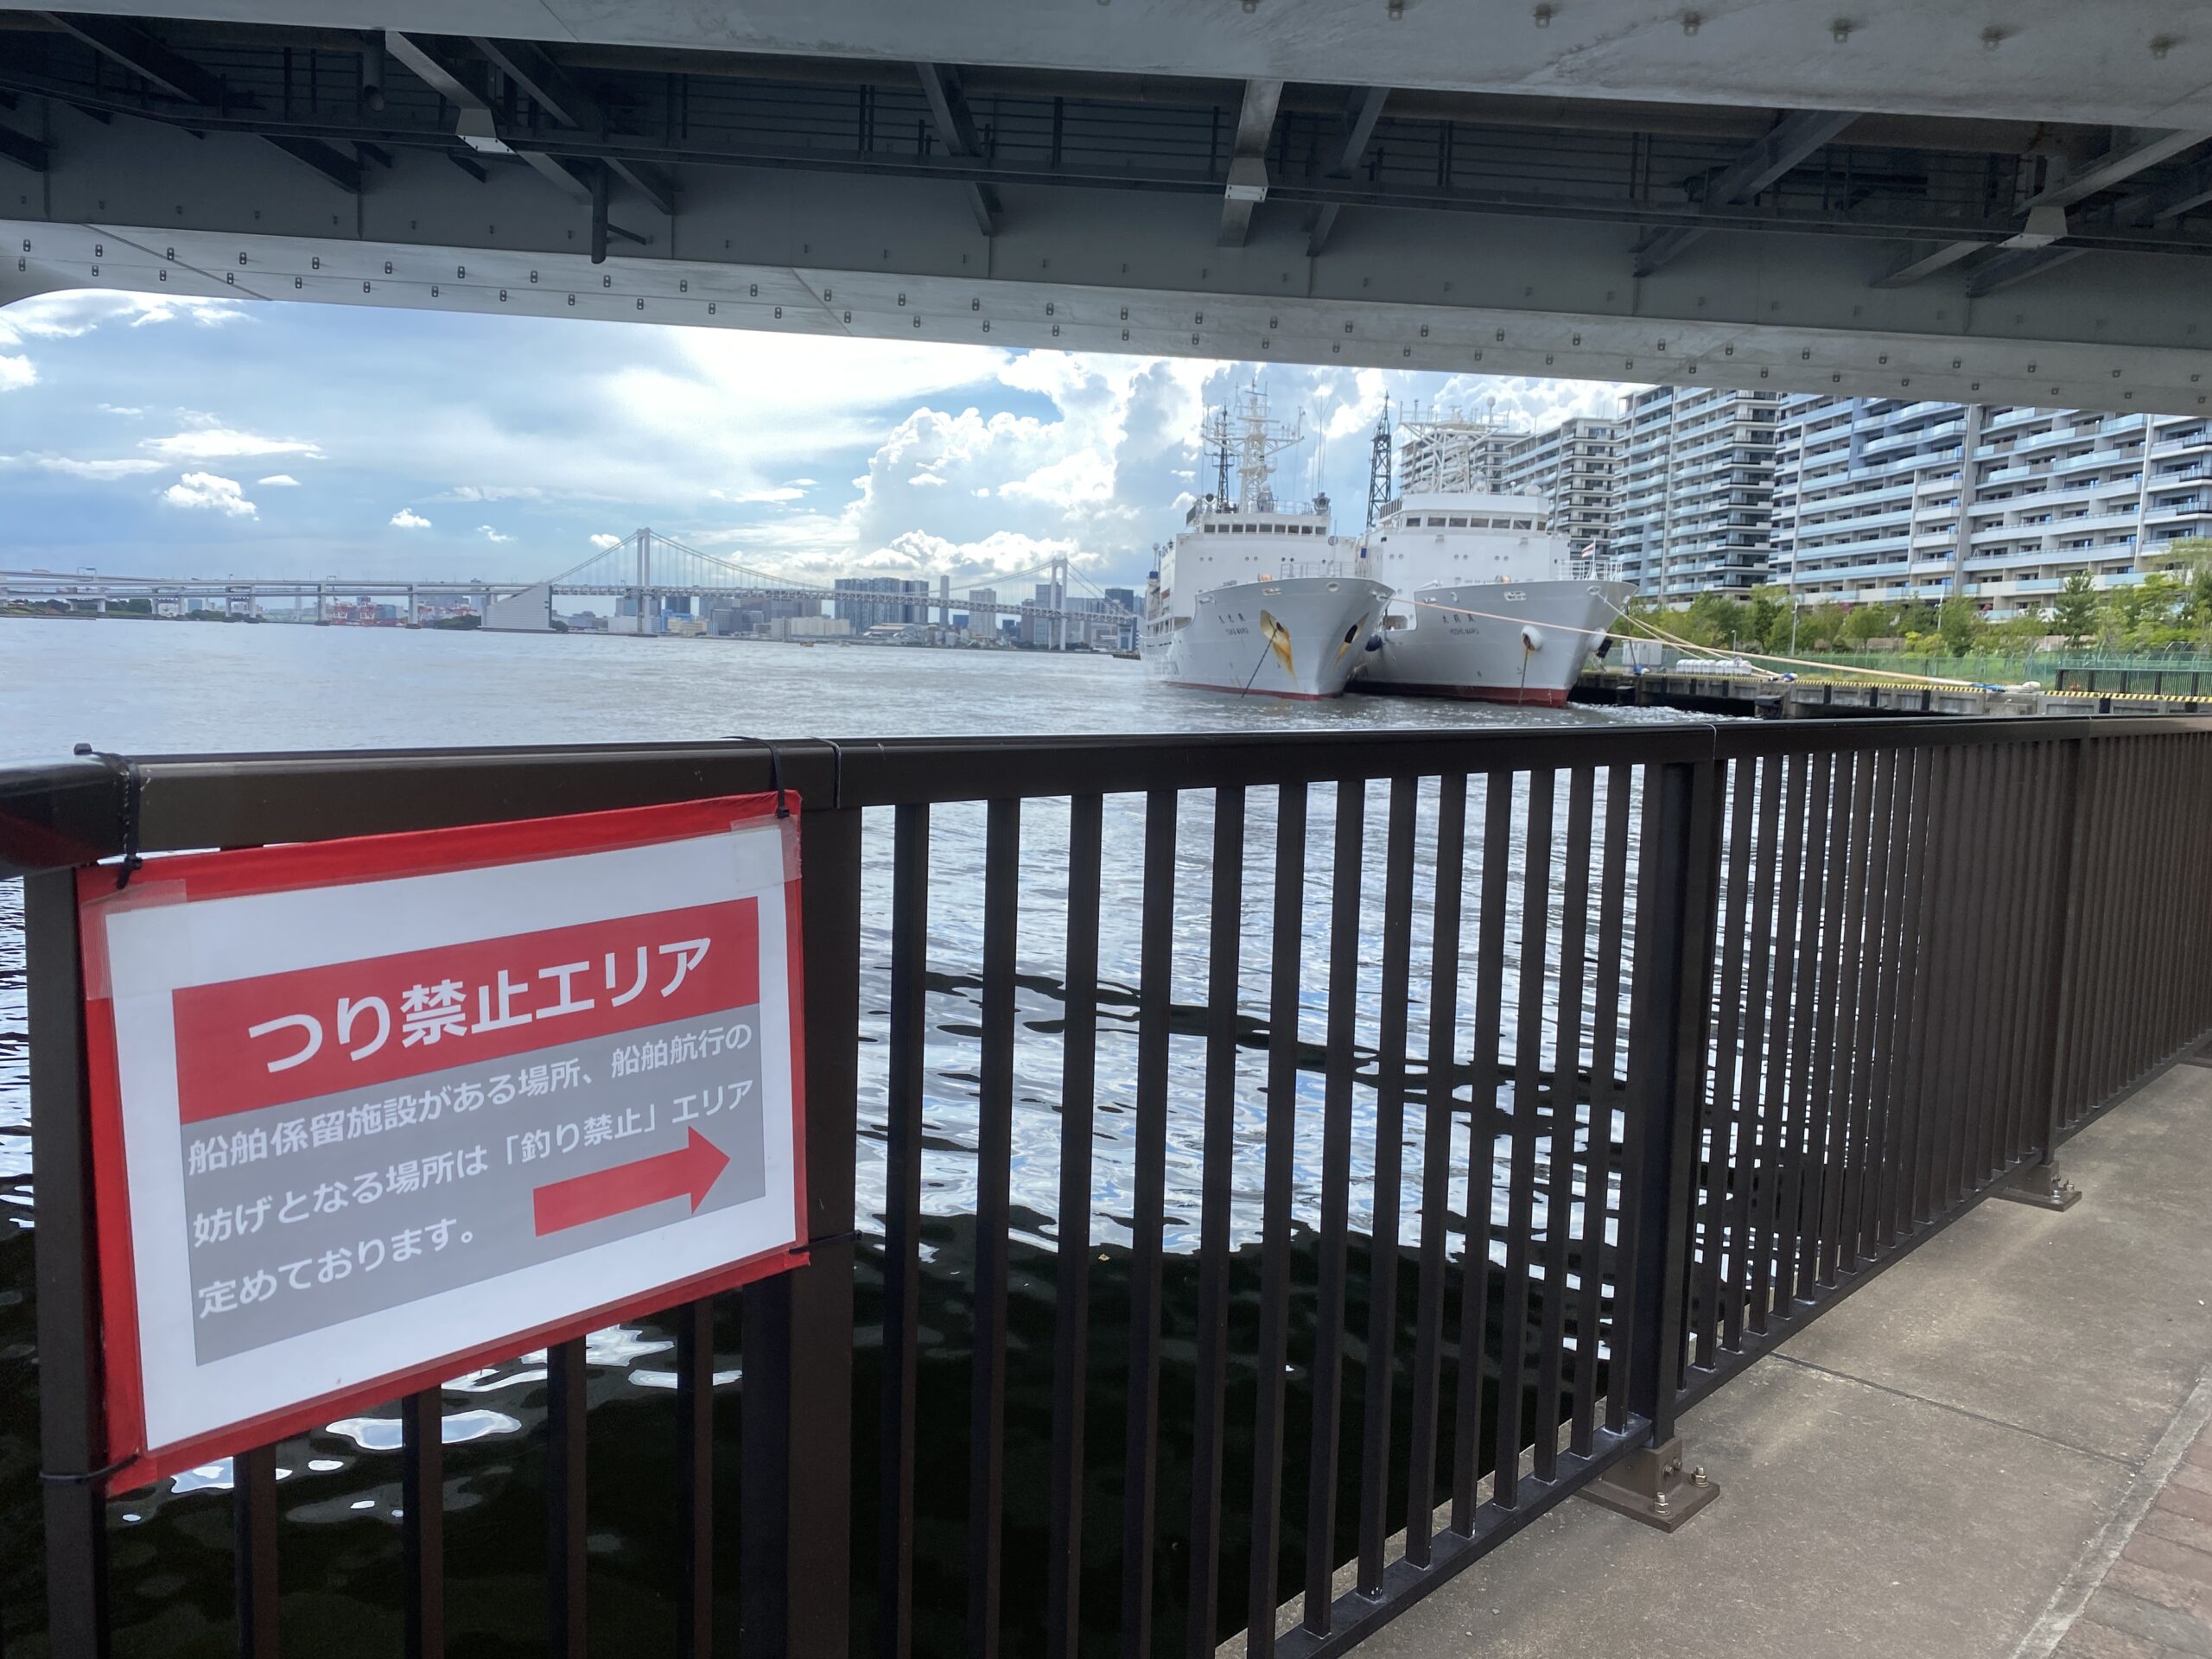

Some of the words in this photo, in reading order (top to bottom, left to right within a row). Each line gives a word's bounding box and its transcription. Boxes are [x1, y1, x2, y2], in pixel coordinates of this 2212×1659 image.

[247, 937, 711, 1073] つり禁止エリア
[198, 1217, 474, 1319] 定めております。
